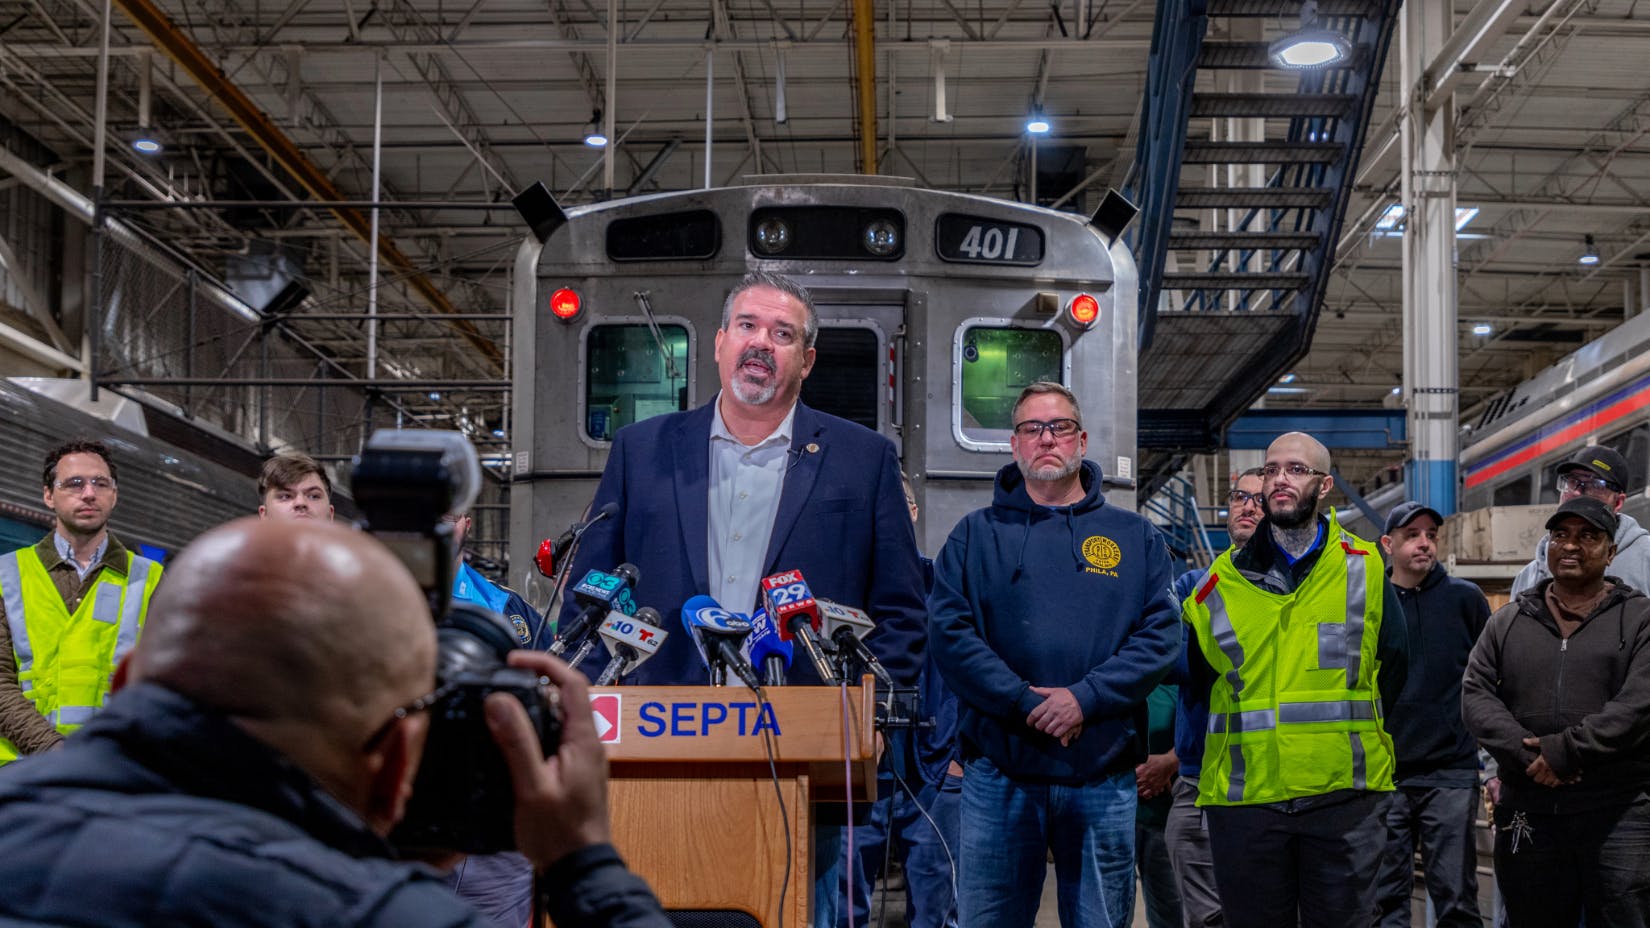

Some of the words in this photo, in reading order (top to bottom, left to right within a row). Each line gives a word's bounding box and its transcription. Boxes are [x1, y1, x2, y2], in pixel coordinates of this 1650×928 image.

[960, 225, 1018, 259] 401
[1085, 567, 1108, 576] PHILA,
[769, 572, 798, 586] FOX
[773, 584, 805, 604] 29
[779, 599, 813, 611] NEWS
[615, 620, 633, 634] 10
[725, 618, 750, 628] abc
[637, 701, 782, 737] SEPTA
